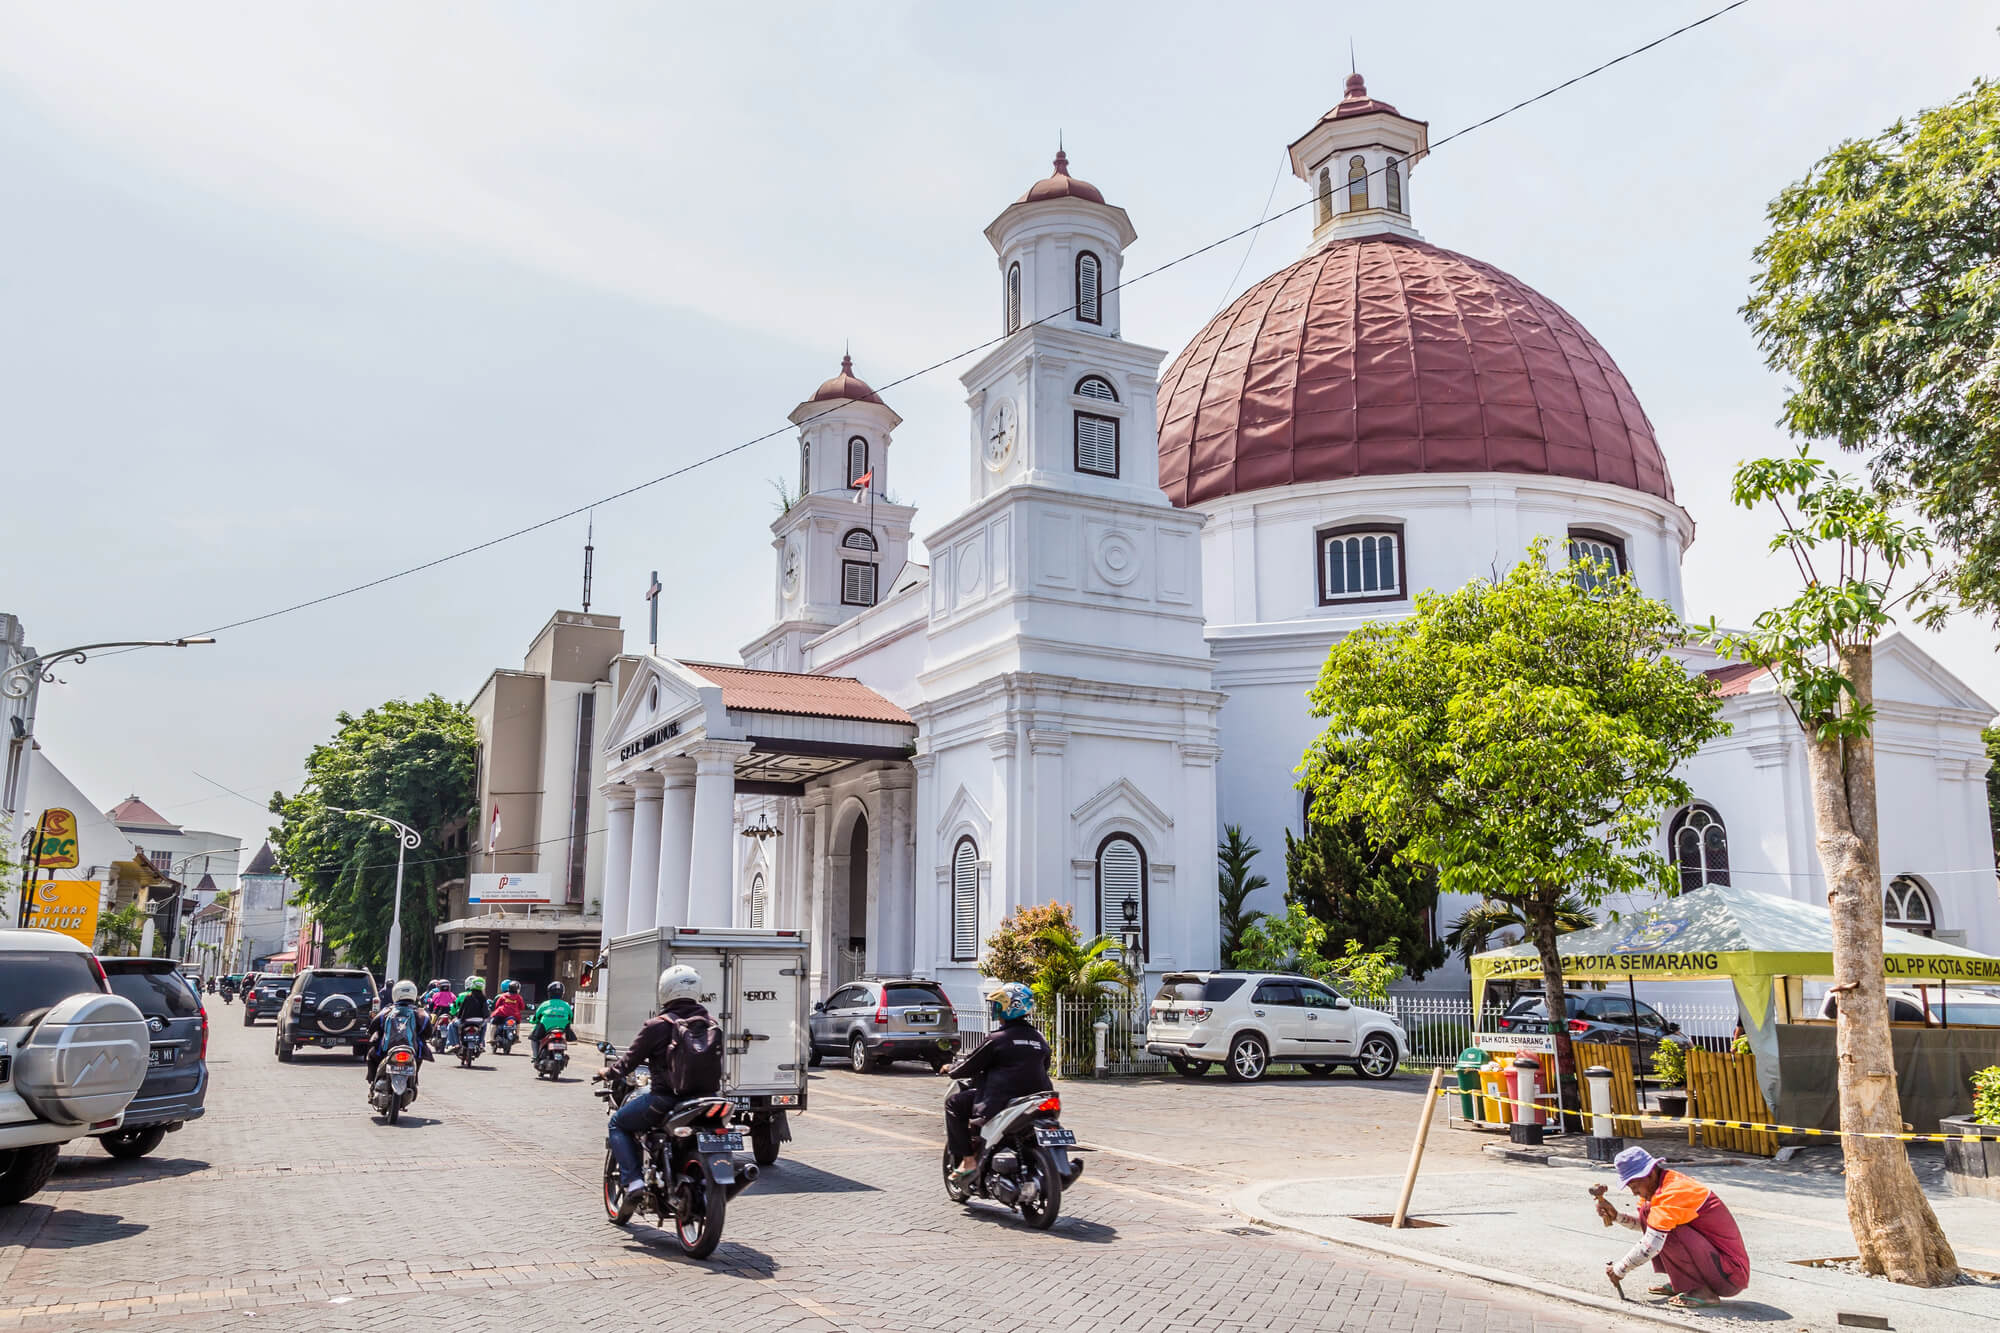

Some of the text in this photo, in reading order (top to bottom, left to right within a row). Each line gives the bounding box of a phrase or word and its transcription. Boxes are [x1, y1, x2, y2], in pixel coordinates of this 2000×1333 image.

[43, 904, 88, 914] BAKAR
[28, 917, 83, 929] ANJUR
[1575, 955, 1616, 970] KOTA
[1620, 953, 1718, 970] SEMARANG
[1907, 958, 1924, 974] PP
[1928, 958, 1964, 975] KOTA
[1494, 1036, 1509, 1044] KOTA
[1510, 1037, 1543, 1045] SEMARANG
